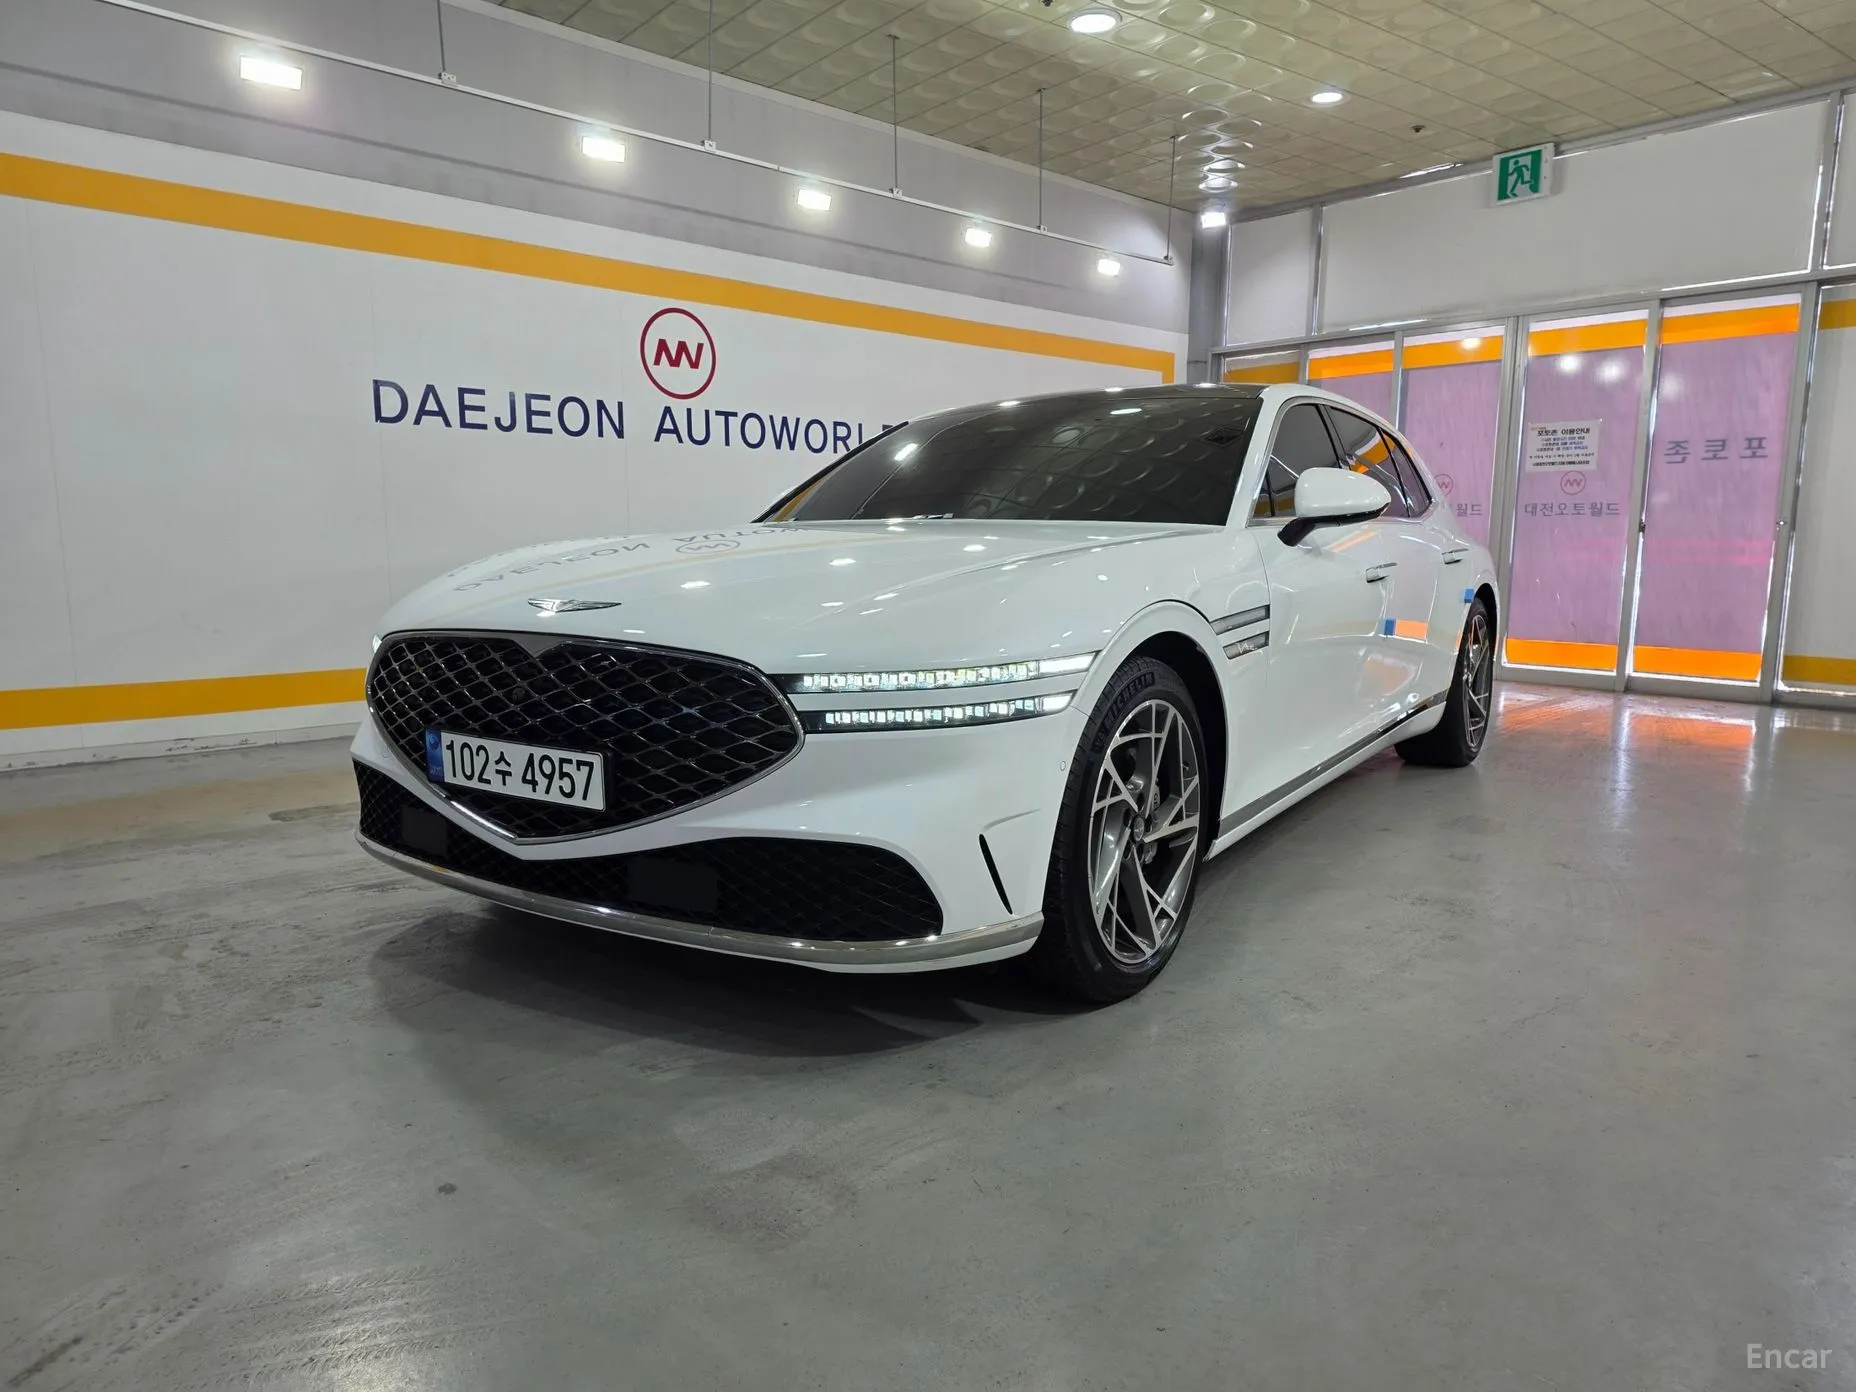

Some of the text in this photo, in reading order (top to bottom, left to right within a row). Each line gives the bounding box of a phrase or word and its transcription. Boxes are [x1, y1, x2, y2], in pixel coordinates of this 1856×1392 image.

[373, 378, 893, 455] DAEJEON AUTOWOR
[1525, 501, 1621, 517] 대전오토월드
[1105, 672, 1155, 729] MICHELIN
[445, 739, 595, 801] 102수 4957
